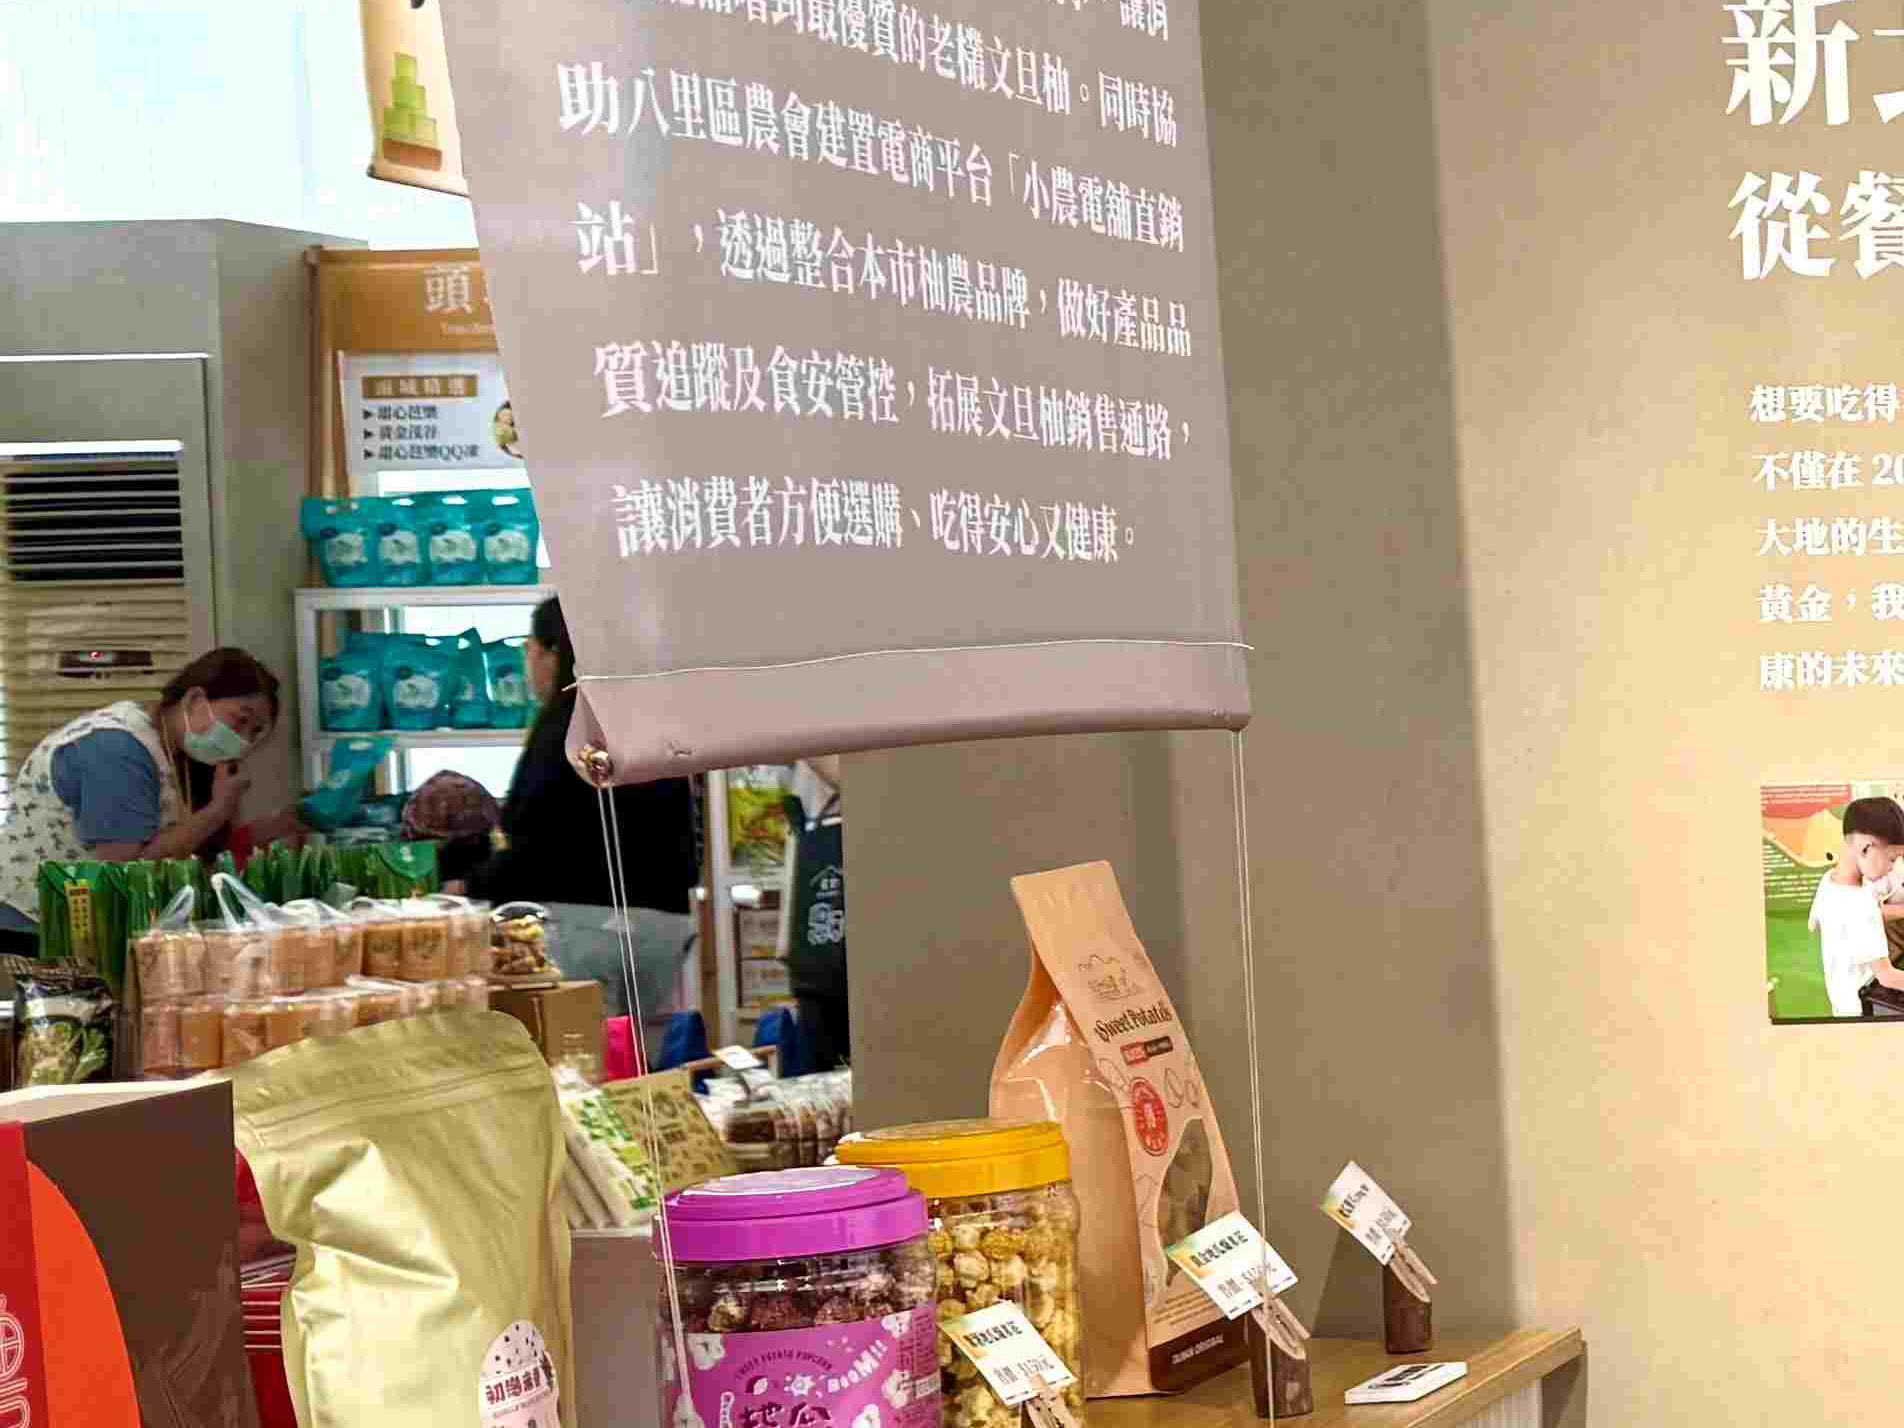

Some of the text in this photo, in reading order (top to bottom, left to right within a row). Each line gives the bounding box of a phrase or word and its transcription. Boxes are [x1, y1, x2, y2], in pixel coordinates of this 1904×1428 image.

[1751, 448, 1864, 492] 不僅在
[609, 474, 1137, 565] 讓消費者方便選購、吃得安心又健康。
